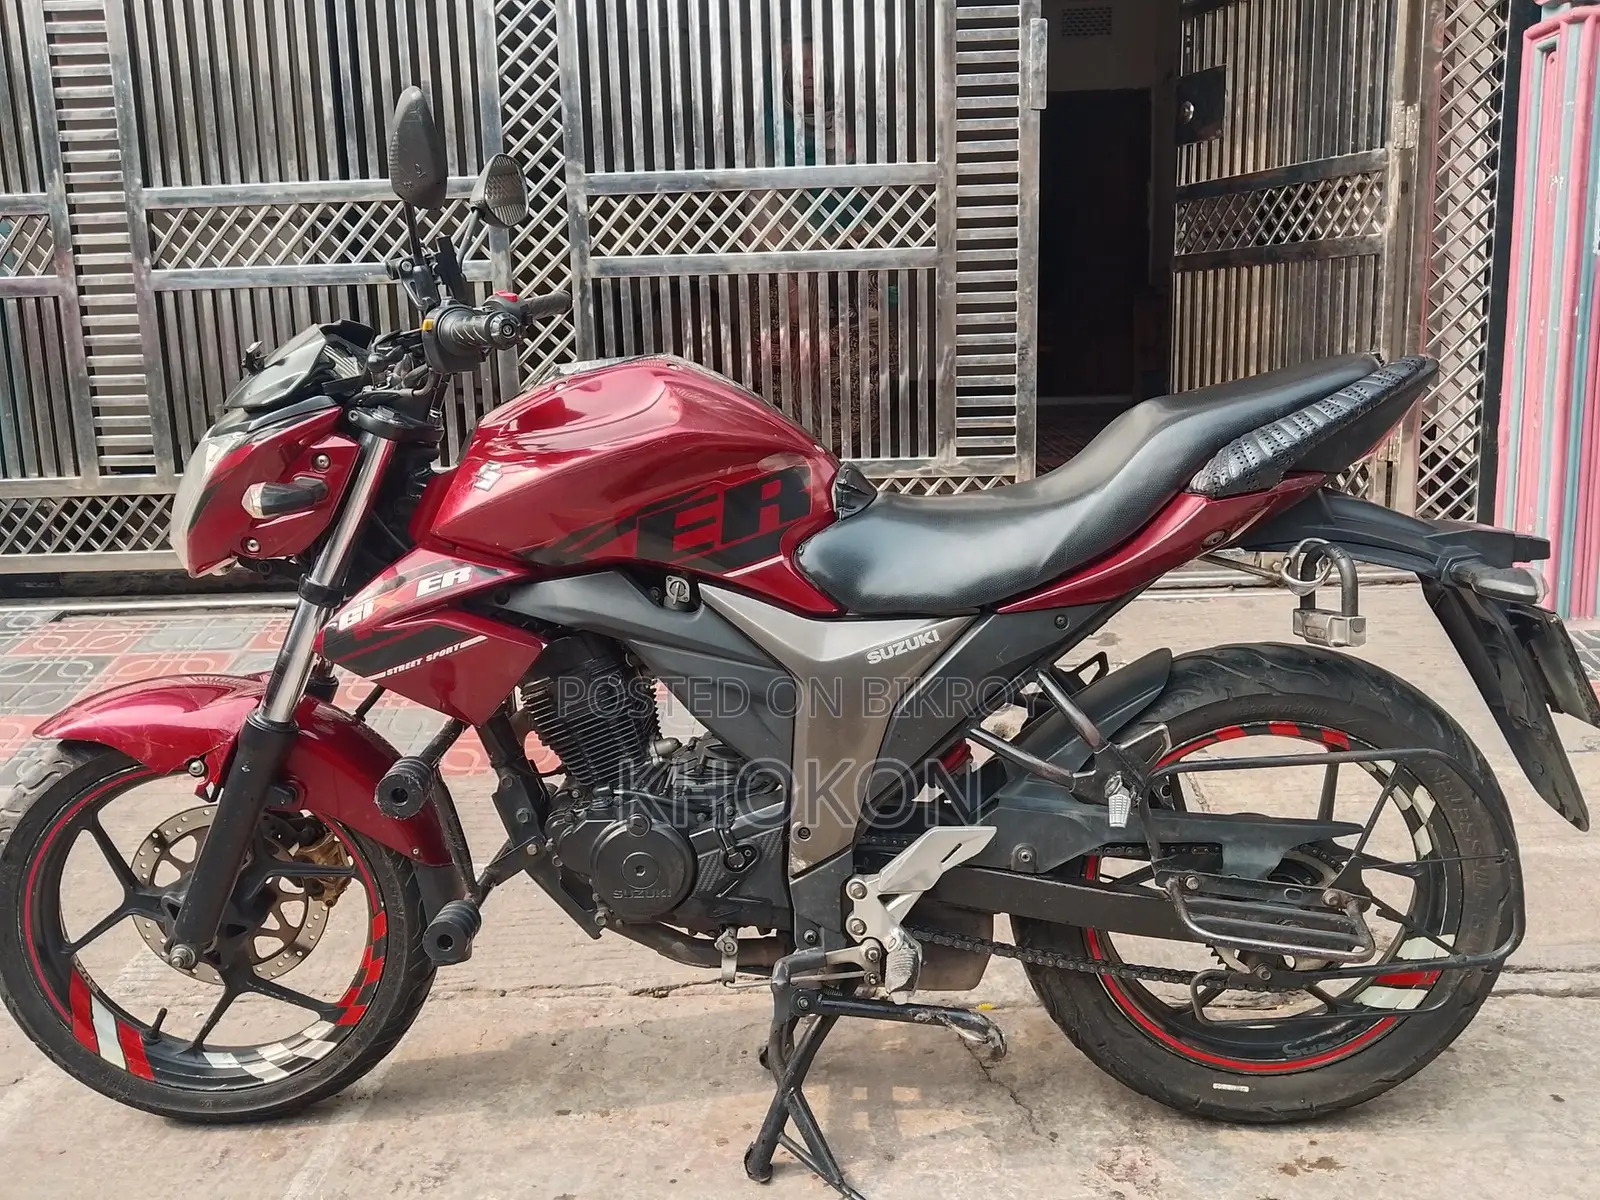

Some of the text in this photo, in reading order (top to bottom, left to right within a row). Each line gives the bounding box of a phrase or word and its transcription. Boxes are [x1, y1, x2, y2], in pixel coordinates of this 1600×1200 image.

[386, 643, 460, 676] STREET SPORT
[866, 629, 940, 664] SUZUKI
[612, 888, 672, 899] SUZUKI
